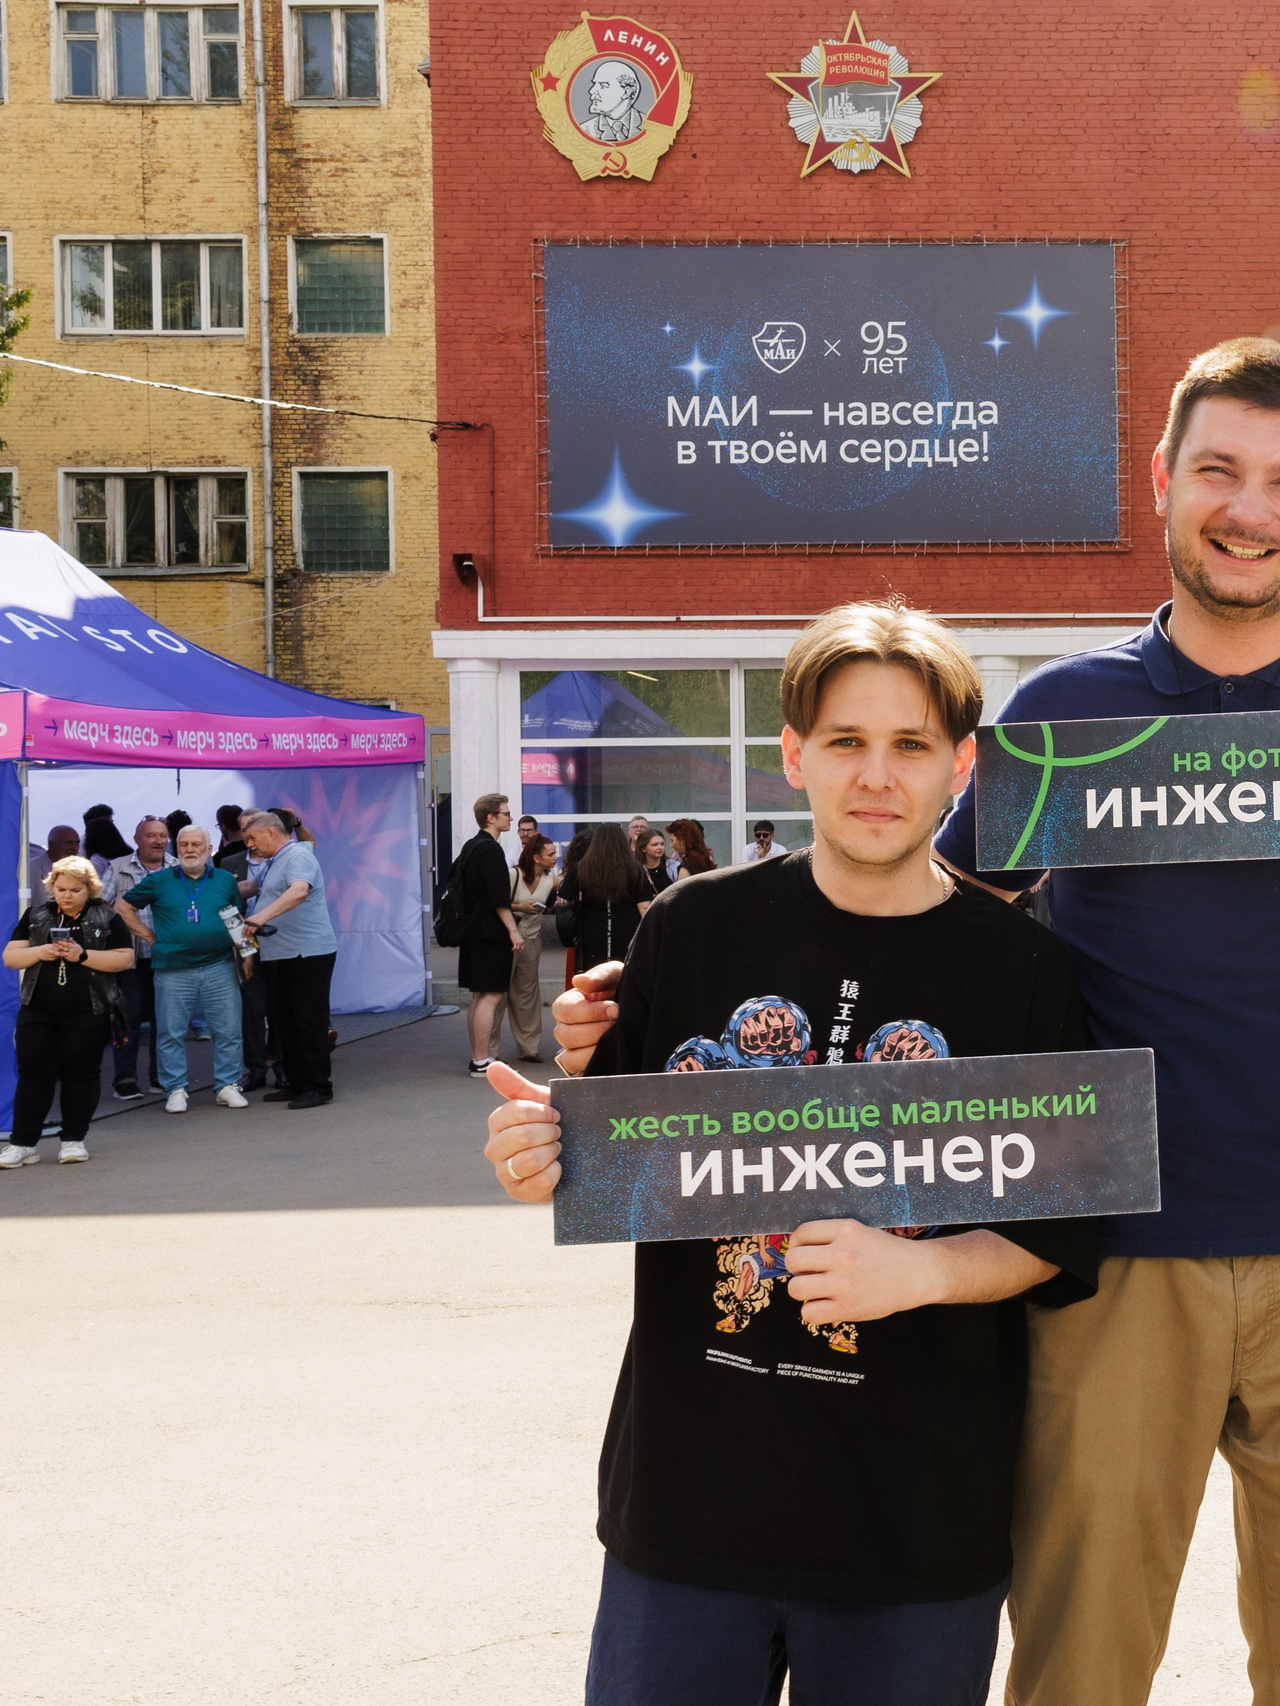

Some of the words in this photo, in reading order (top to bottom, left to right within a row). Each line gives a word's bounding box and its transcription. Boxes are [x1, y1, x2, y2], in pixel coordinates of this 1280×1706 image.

[603, 29, 670, 66] ЛЕНИН
[826, 52, 888, 68] ОКТЯБРЬСКАЯ
[829, 65, 885, 79] РЕВОЛЮЦИЯ
[860, 321, 908, 355] 95
[861, 357, 908, 374] лет
[667, 395, 758, 427] МАИ
[823, 400, 999, 430] навсегда
[677, 440, 697, 465] в
[707, 431, 827, 465] твоём
[839, 431, 989, 472] сердце!
[63, 719, 109, 749] мерч
[113, 724, 159, 749] здесь
[177, 730, 215, 755] мерч
[218, 731, 258, 753] здесь
[271, 732, 305, 755] мерч
[306, 731, 339, 753] здесь
[351, 732, 378, 754] мерч
[379, 731, 408, 752] здесь
[1173, 751, 1211, 772] на
[609, 1112, 722, 1141] жесть
[732, 1098, 880, 1135] вообще
[892, 1085, 1097, 1127] маленький
[680, 1132, 1036, 1198] инженер
[777, 1362, 795, 1370] EVERY
